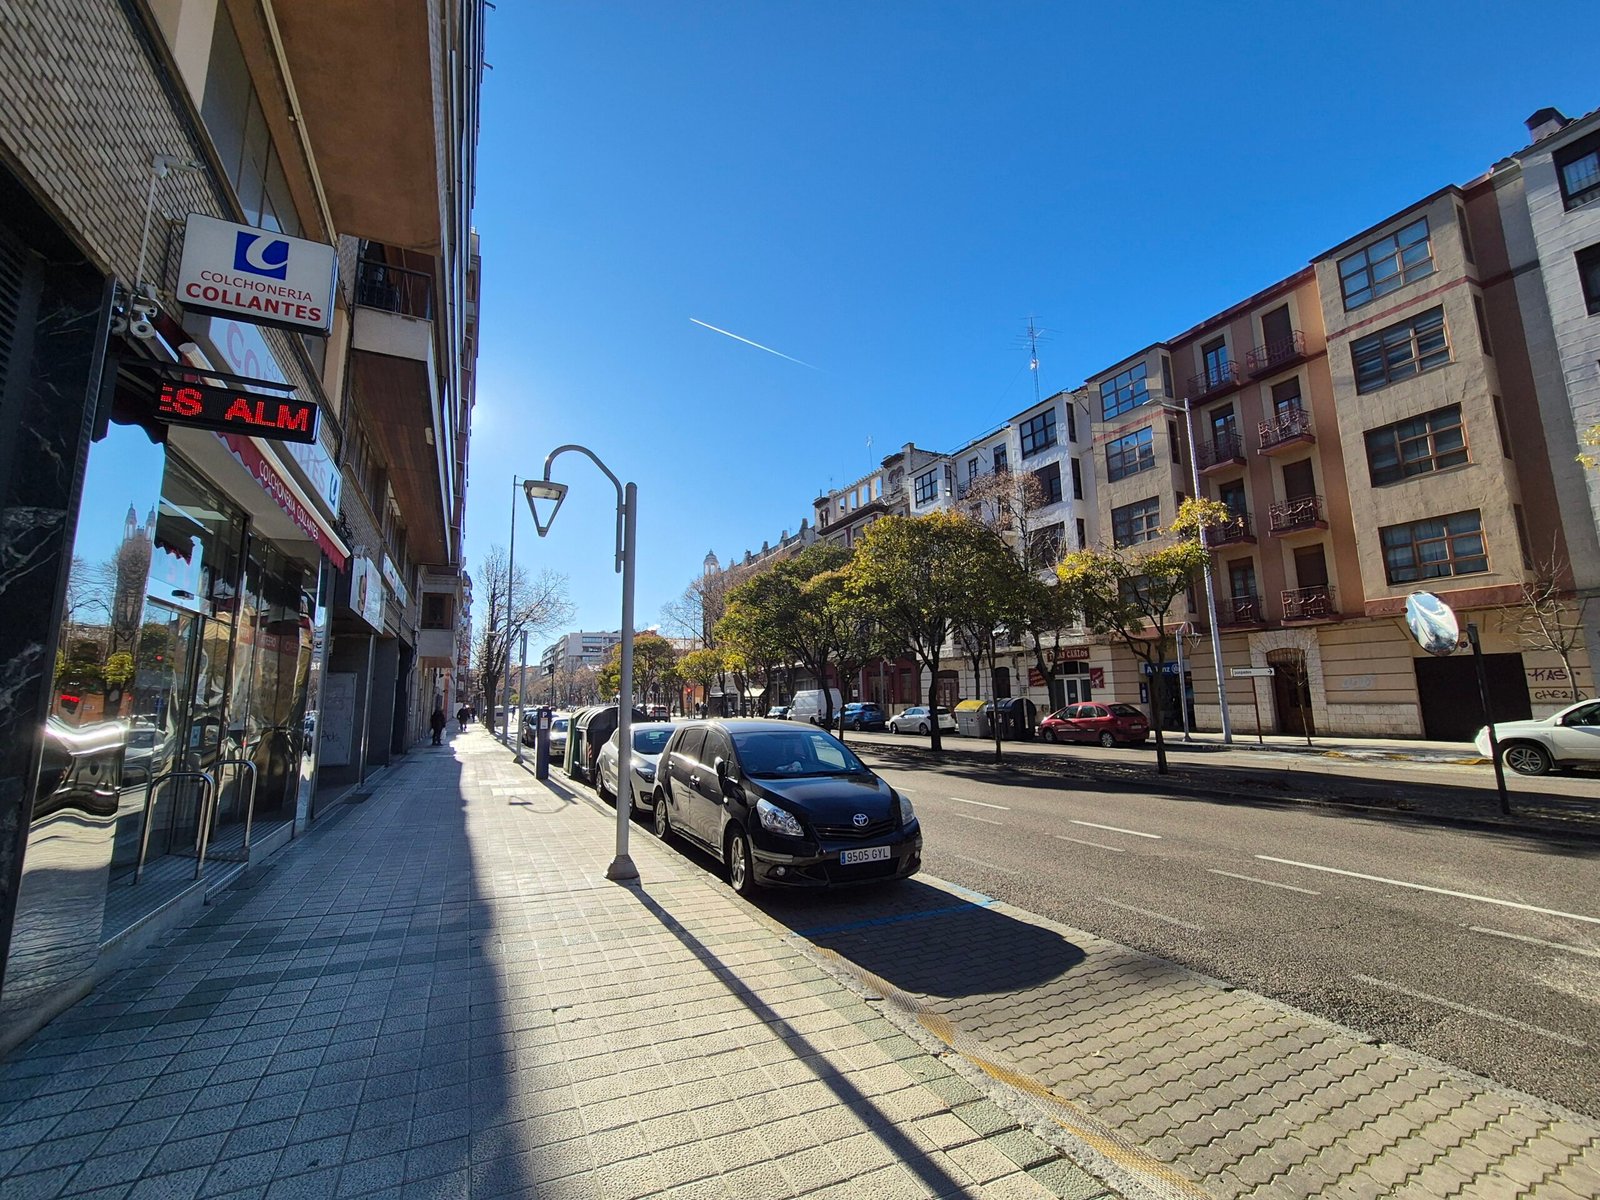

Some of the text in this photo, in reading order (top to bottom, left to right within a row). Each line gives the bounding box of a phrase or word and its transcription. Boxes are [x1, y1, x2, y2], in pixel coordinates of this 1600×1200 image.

[185, 282, 321, 322] COLLANTES
[200, 270, 312, 302] COLCHONERIA
[225, 397, 308, 431] ALM
[259, 459, 319, 540] COLCHONERIA COLLANTES
[847, 848, 888, 862] 9505 GYL
